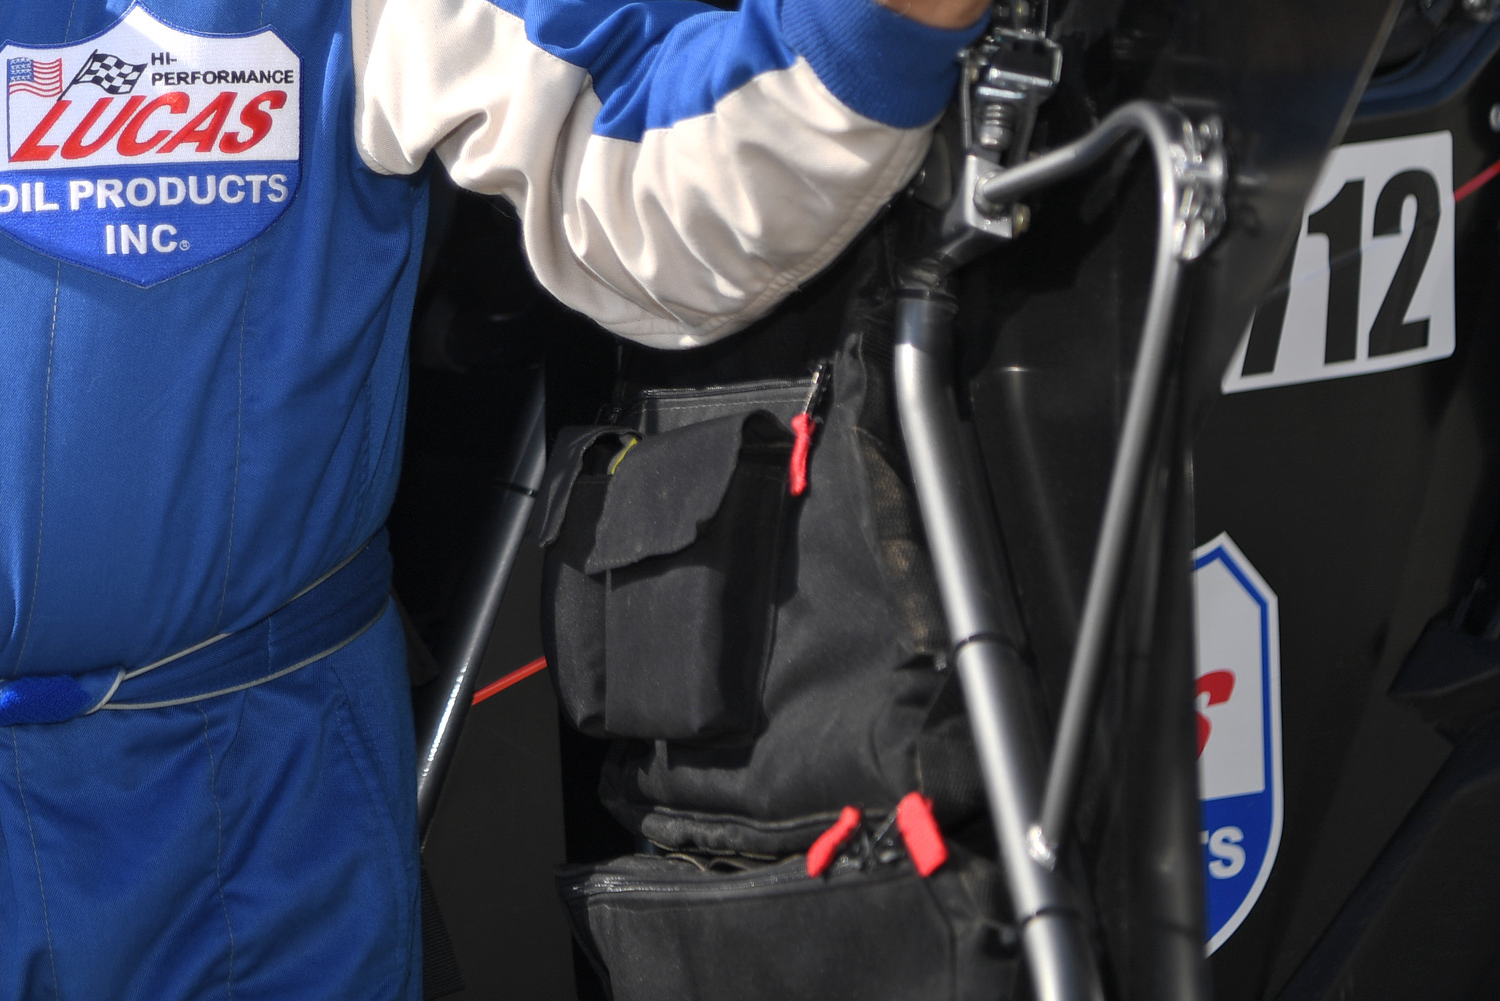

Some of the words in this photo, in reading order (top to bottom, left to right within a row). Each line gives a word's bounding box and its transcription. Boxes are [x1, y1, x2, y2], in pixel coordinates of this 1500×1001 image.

[150, 51, 178, 67] HI-
[151, 69, 296, 87] PERFORMANCE
[8, 90, 288, 163] LUCAS
[69, 173, 289, 211] PRODUCTS
